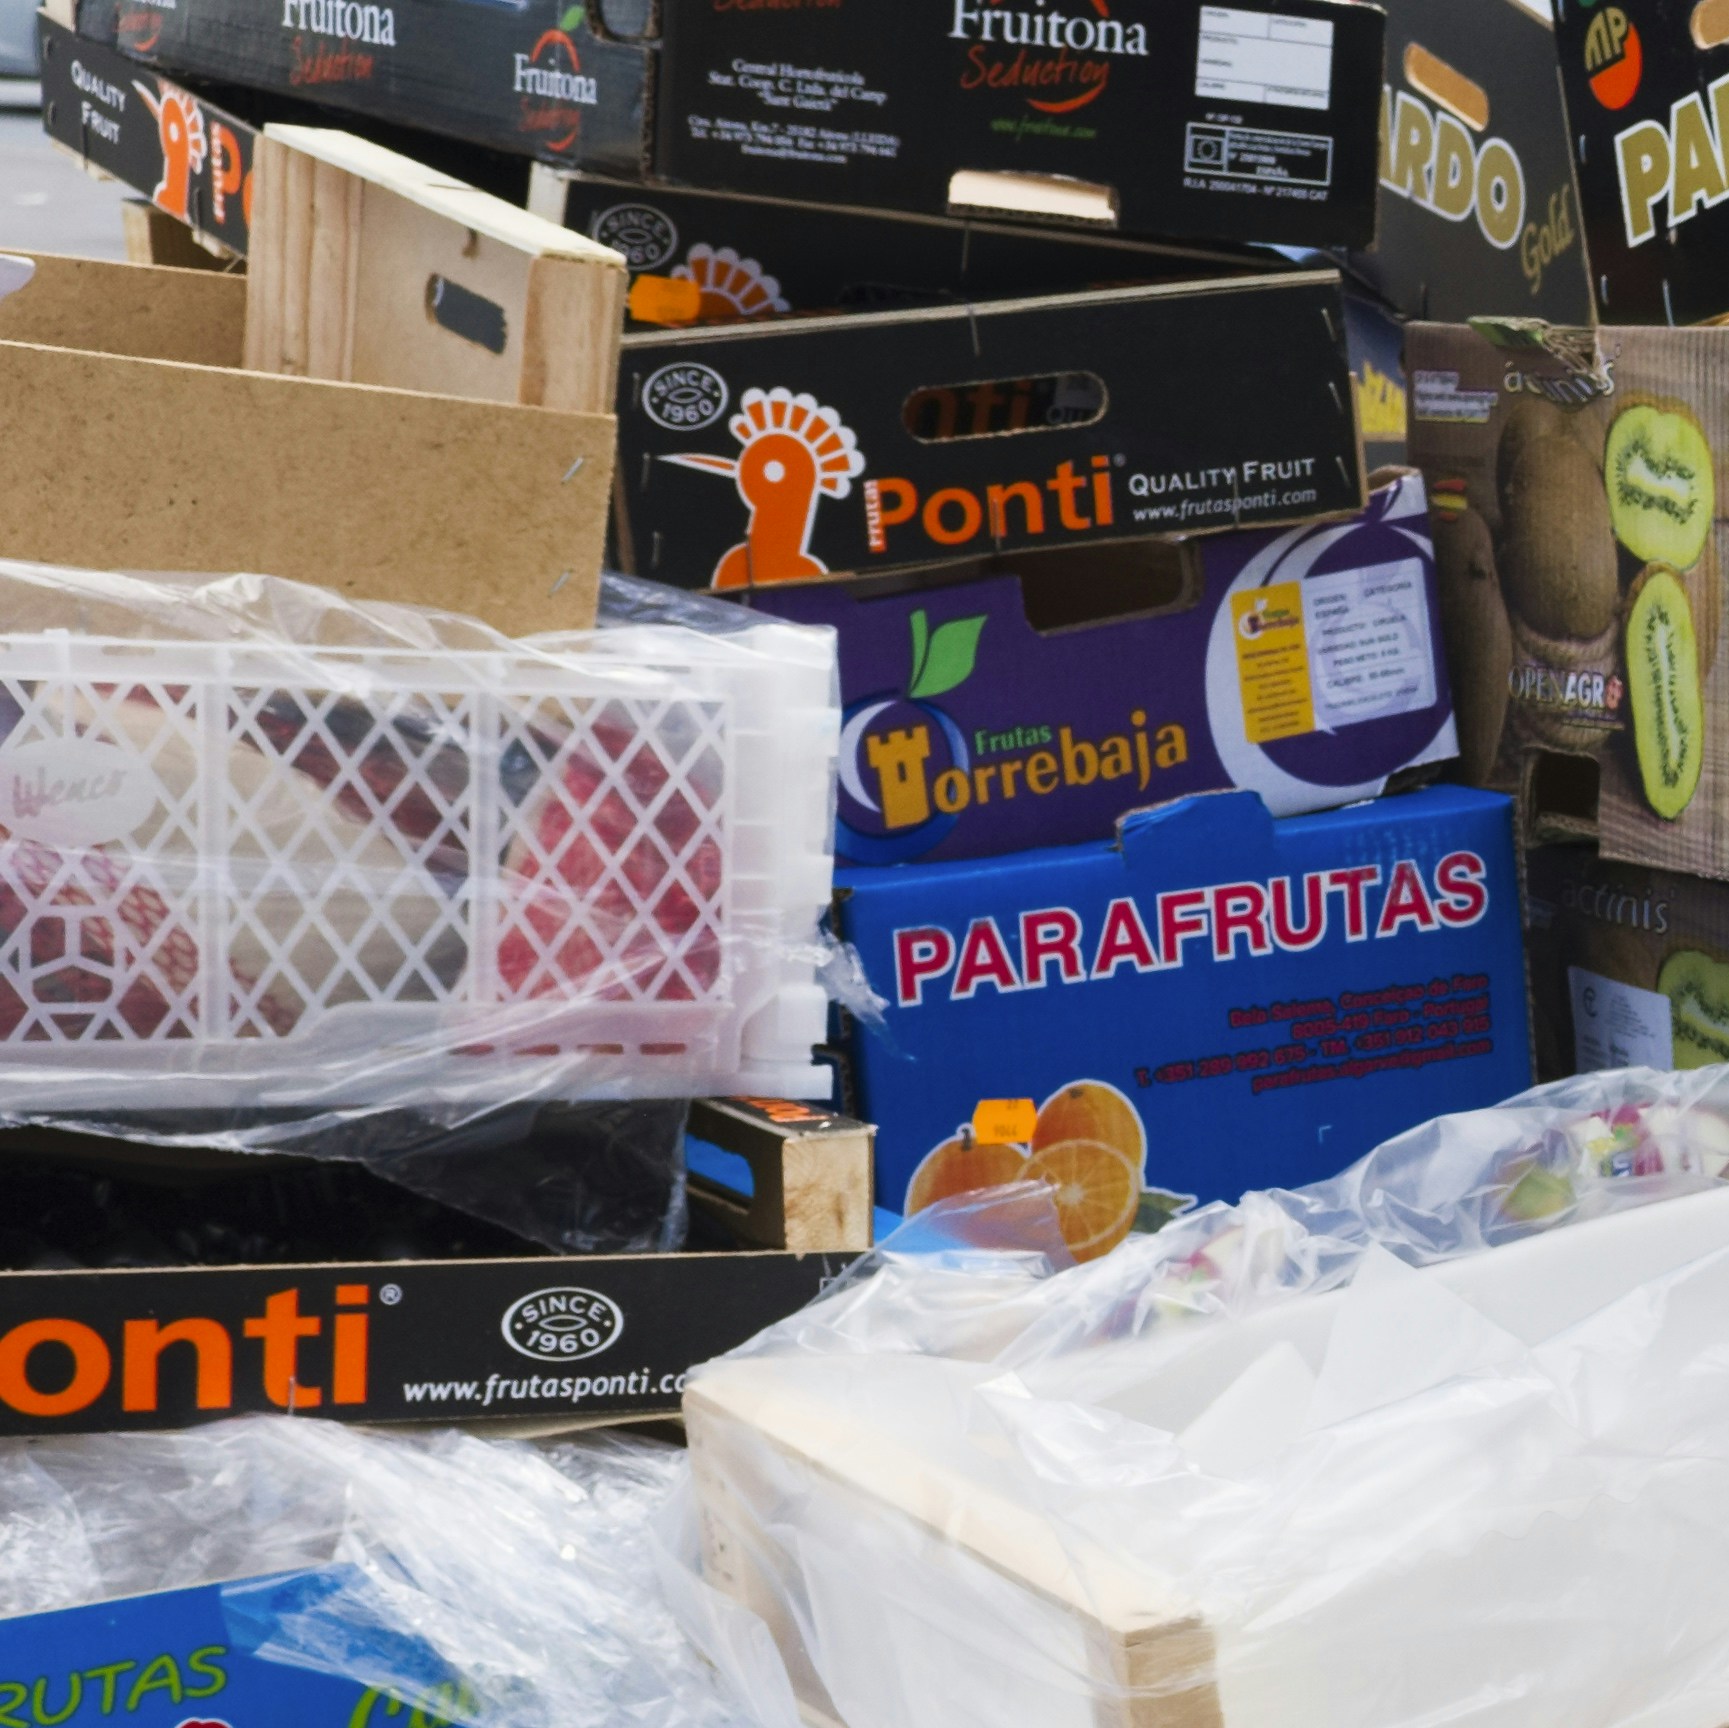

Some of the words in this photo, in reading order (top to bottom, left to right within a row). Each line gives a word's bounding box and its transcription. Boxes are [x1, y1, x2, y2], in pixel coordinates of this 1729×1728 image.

[282, 0, 396, 46] Fruitona
[949, 0, 1149, 56] Fruitona
[514, 53, 597, 104] Fruitona
[1520, 183, 1574, 295] Gold
[654, 370, 714, 395] SINCE
[661, 400, 714, 422] 1960
[1128, 468, 1237, 498] QUALITY
[1243, 458, 1316, 482] FRUIT
[878, 455, 1114, 551] Ponti
[1132, 486, 1317, 522] www.frutasponti.com
[974, 720, 1053, 757] Frutas
[892, 849, 1489, 1009] PARAFRUTAS
[521, 1295, 605, 1324] SINCE
[0, 1283, 370, 1418] onti
[524, 1328, 601, 1356] 1960
